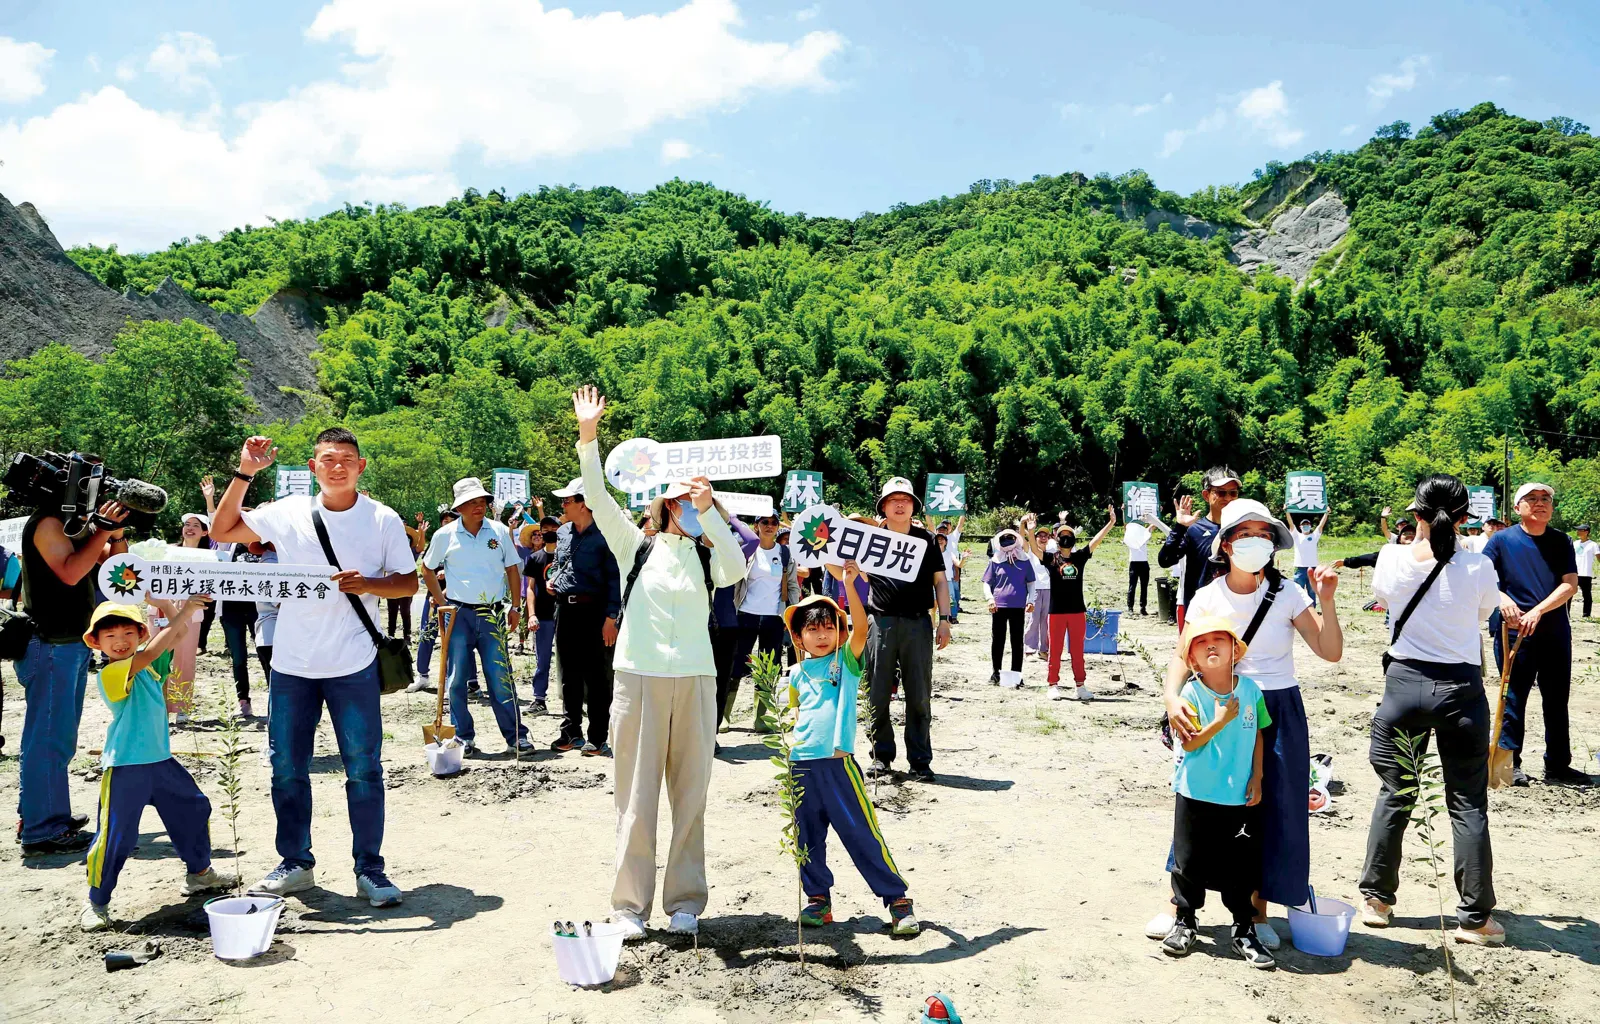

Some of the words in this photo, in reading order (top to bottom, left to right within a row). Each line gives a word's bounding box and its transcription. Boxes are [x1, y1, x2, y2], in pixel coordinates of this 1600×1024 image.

[666, 441, 773, 465] 日月光投控
[665, 467, 694, 479] ASE
[697, 461, 774, 477] HOLDINGS
[494, 472, 528, 505] 願
[785, 474, 821, 509] 林
[928, 478, 964, 512] 永
[1127, 485, 1159, 521] 續
[1288, 475, 1326, 510] 環
[837, 527, 918, 574] 日月光
[150, 565, 196, 575] 財團法人
[150, 578, 332, 600] 日月光環保永續基金會
